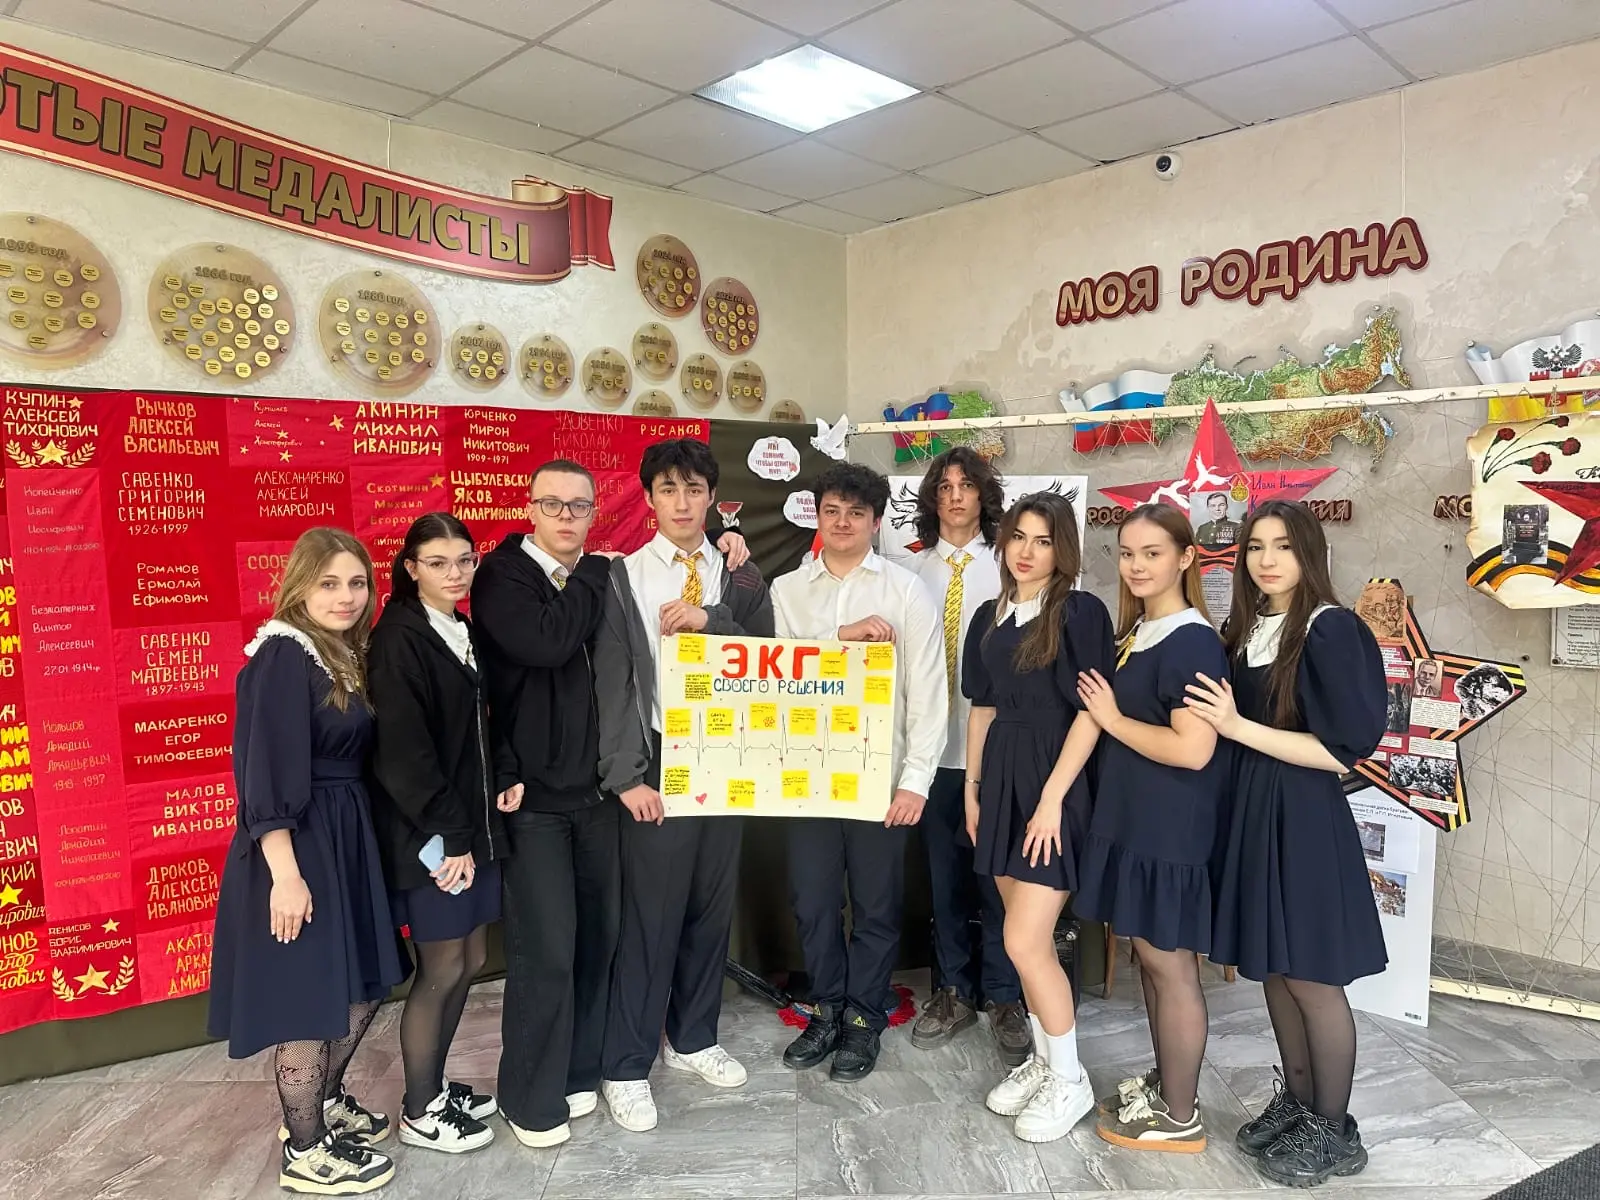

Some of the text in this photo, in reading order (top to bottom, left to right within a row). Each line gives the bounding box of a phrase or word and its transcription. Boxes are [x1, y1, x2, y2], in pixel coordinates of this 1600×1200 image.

[0, 66, 531, 266] ТЫЕ МЕДАЛИСТЫ
[1056, 217, 1429, 327] МОЯ РОДИНА
[6, 389, 66, 409] КУПИН
[3, 407, 81, 423] АЛЕКСЕЙ
[355, 401, 439, 420] АКИНИН
[463, 407, 517, 423] ЮРЧЕНКО
[3, 421, 99, 438] ТИХОНОВИЧ
[353, 421, 439, 438] МИХАИЛ
[469, 422, 510, 438] МИРОН
[640, 424, 701, 436] РУСАНОВ
[353, 438, 442, 456] ИВАНОВИЧ
[463, 436, 530, 453] НИКИТОВИЧ
[121, 471, 194, 489] САВЕНКО
[450, 470, 532, 488] ЦЫБУЛЕВСКИ
[118, 487, 205, 505] ГРИГОРИЙ
[257, 485, 309, 501] АЛЕКСЕЙ
[454, 487, 493, 504] ЯКОВ
[118, 504, 204, 522] СЕМЕНОВИЧ
[259, 502, 335, 518] МАКАРОВИЧ
[452, 504, 530, 521] ИЛЛАРИОНОВИ
[1433, 495, 1472, 519] МО
[128, 522, 189, 536] 1926-1999
[140, 630, 211, 650] САВЕНКО
[721, 643, 820, 680] ЭКГ
[131, 664, 220, 685] МАТВЕЕВИЧ
[145, 681, 206, 696] 1897-1943
[713, 678, 770, 693] СВОЕГО
[778, 680, 844, 695] РЕШЕНИЯ
[134, 713, 228, 734] МАКАРЕНКО
[165, 732, 202, 747] ЕГОР
[133, 744, 234, 766] ТИМОФЕЕВИЧ
[166, 783, 226, 802] МАЛОВ
[163, 797, 236, 820] ВИКТОР
[152, 814, 238, 839] ИВАНОВИ
[146, 858, 210, 886] ДРОКОВ
[148, 872, 219, 902] АЛЕКСЕЙ
[48, 922, 92, 936] ДЕНИСОВ
[49, 935, 82, 947] БОРИС
[50, 936, 132, 959] ВЛАДИМИРОВИЧ
